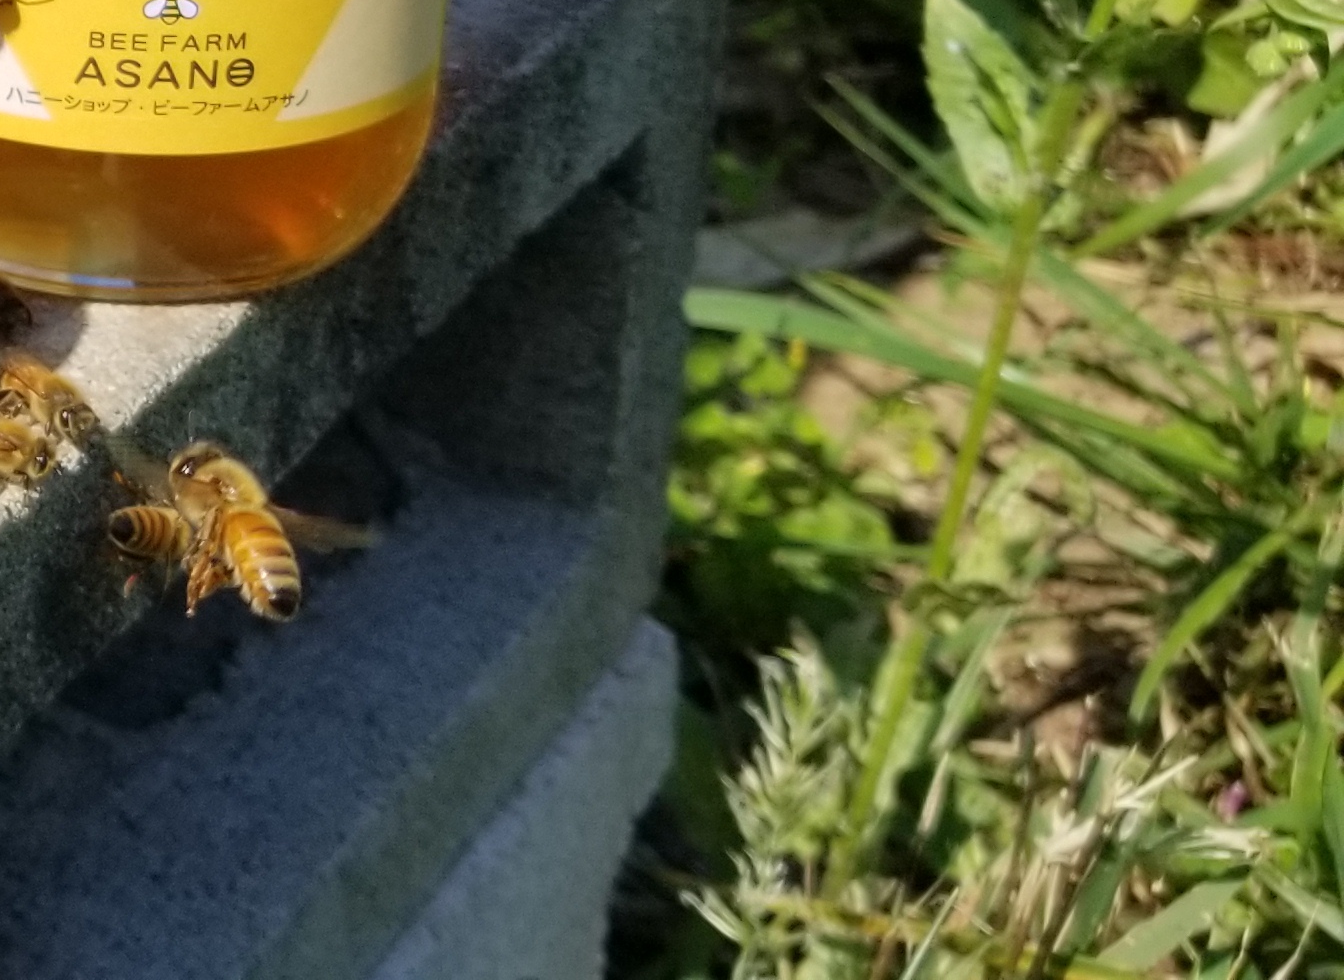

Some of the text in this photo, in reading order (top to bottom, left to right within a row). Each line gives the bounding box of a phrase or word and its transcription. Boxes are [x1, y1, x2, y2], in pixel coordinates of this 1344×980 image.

[88, 31, 248, 52] BEE FARM
[74, 56, 255, 89] ASANO
